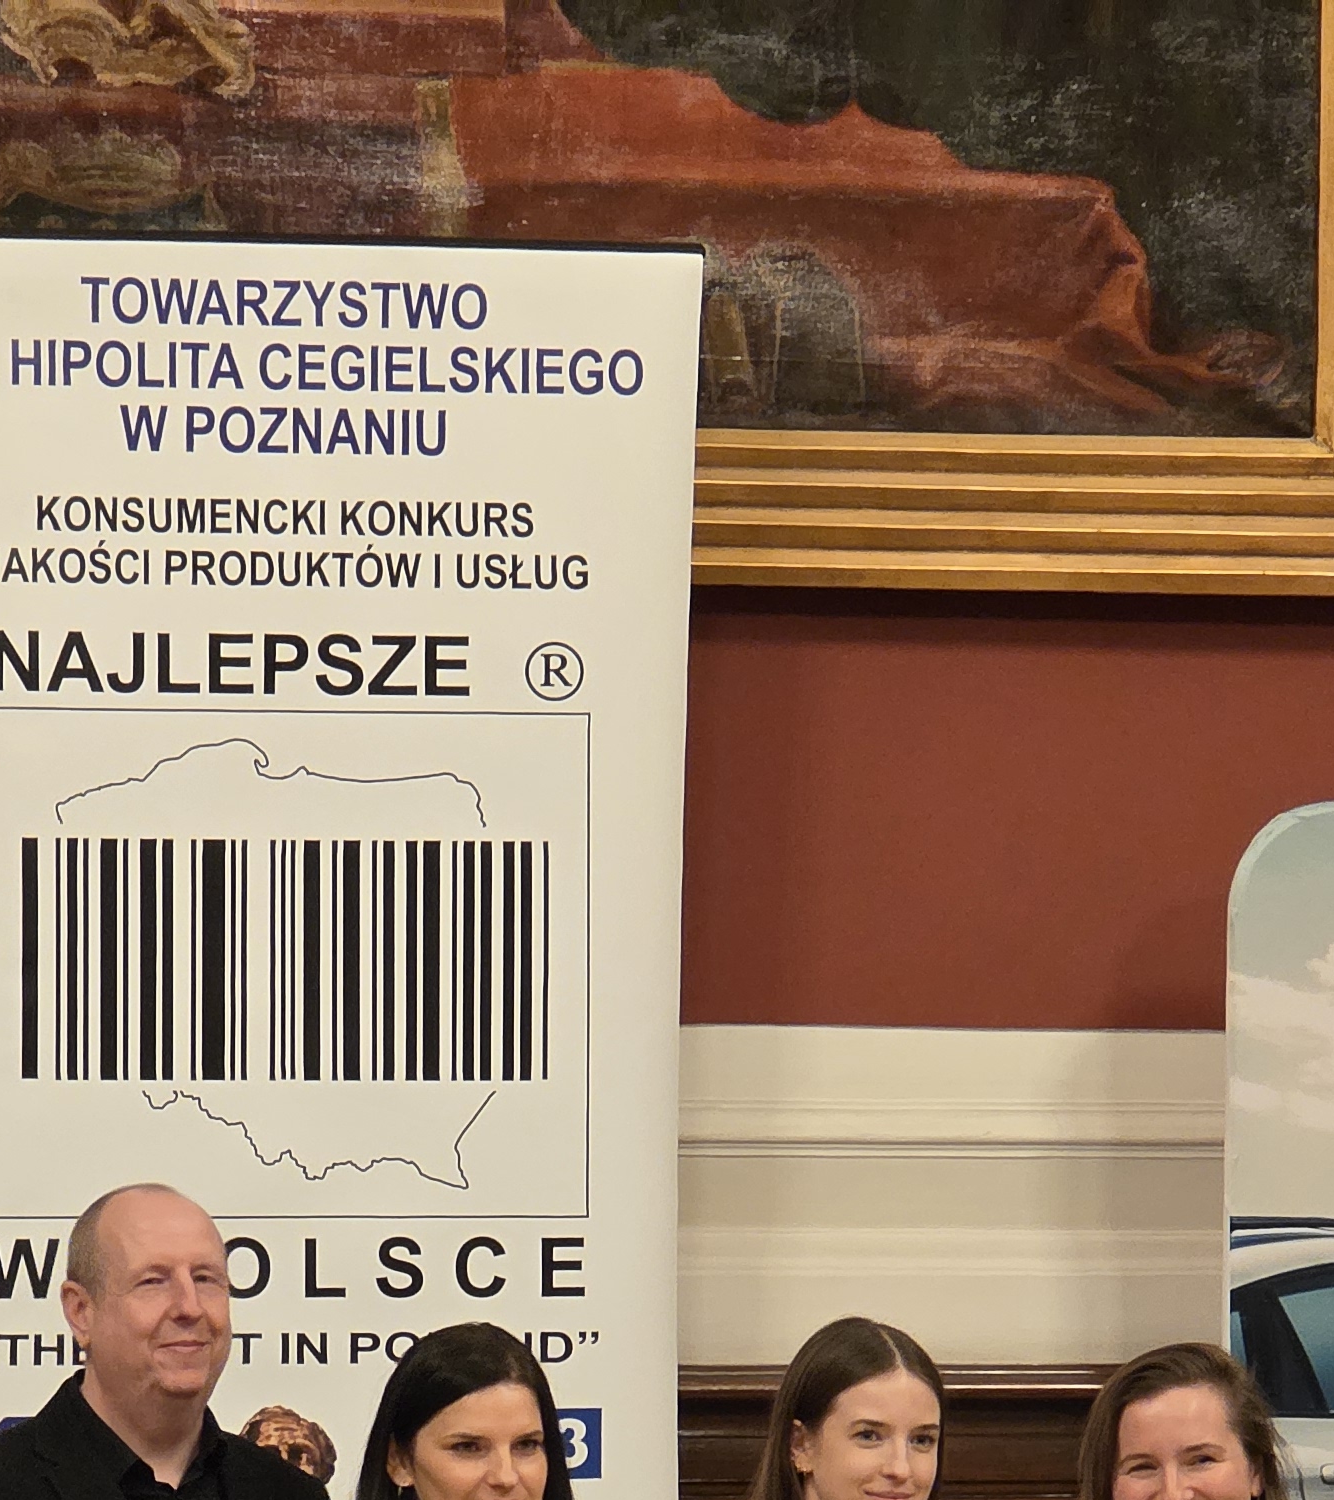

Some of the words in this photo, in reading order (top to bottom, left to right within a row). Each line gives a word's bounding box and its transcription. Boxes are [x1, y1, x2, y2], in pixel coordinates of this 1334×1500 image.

[80, 276, 488, 331] TOWARZYSTWO
[11, 338, 244, 390] HIPOLITA
[259, 342, 644, 396] CEGIELSKIEGO
[119, 404, 168, 452] W
[185, 405, 447, 457] POZNANIU
[36, 495, 326, 536] KONSUMENCKI
[340, 500, 534, 538] KONKURS
[164, 543, 422, 589] PRODUKTÓW
[433, 553, 442, 589] I
[456, 553, 589, 590] USŁUG
[224, 1236, 586, 1299] OLSCE
[281, 1332, 328, 1365] IN
